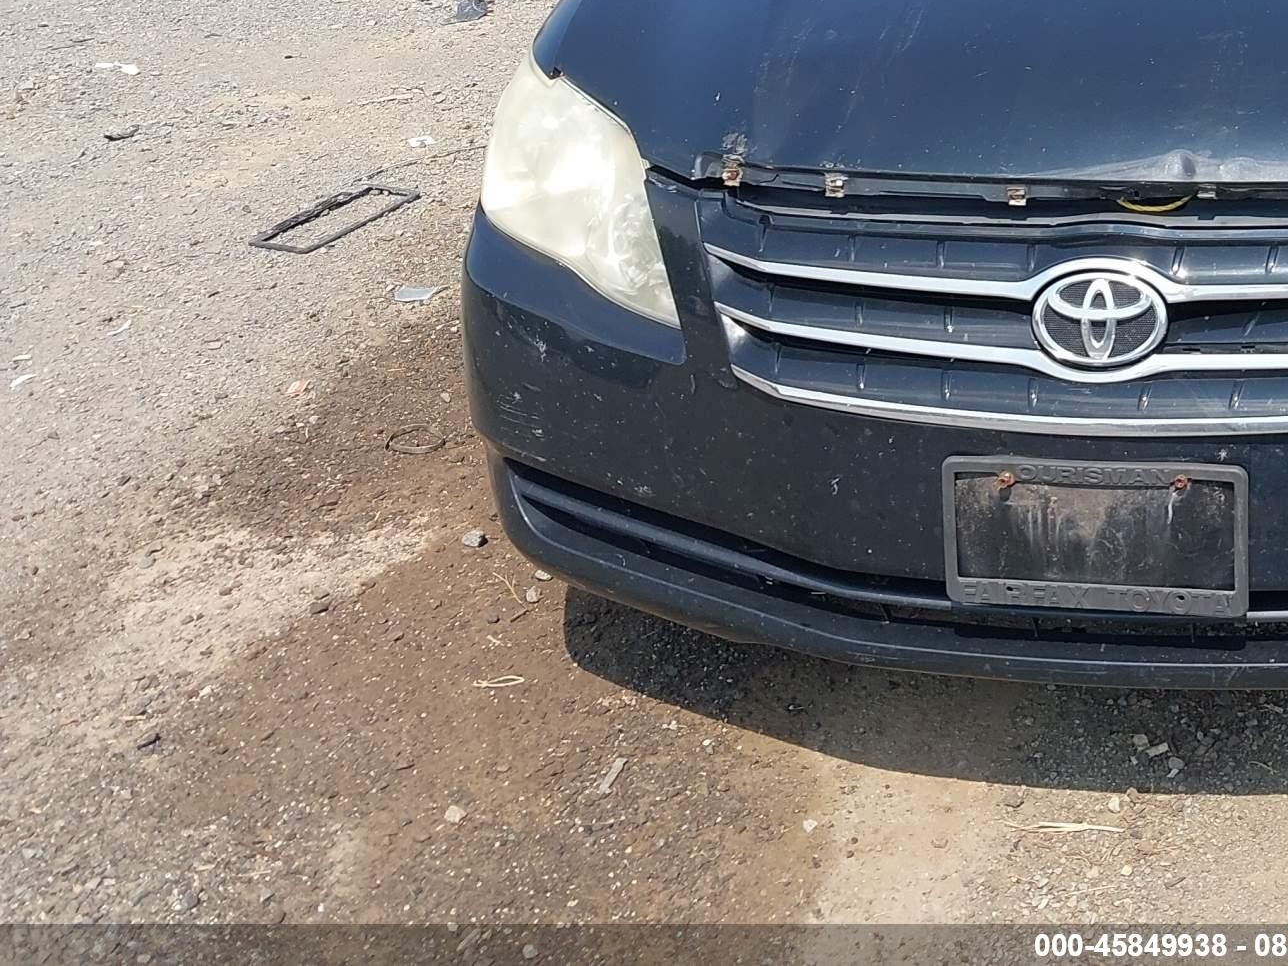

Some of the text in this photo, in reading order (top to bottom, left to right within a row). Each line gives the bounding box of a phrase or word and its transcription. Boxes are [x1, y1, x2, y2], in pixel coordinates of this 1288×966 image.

[1016, 464, 1170, 485] OURISMAN
[963, 583, 1234, 615] FAIRFAX TOYOTA
